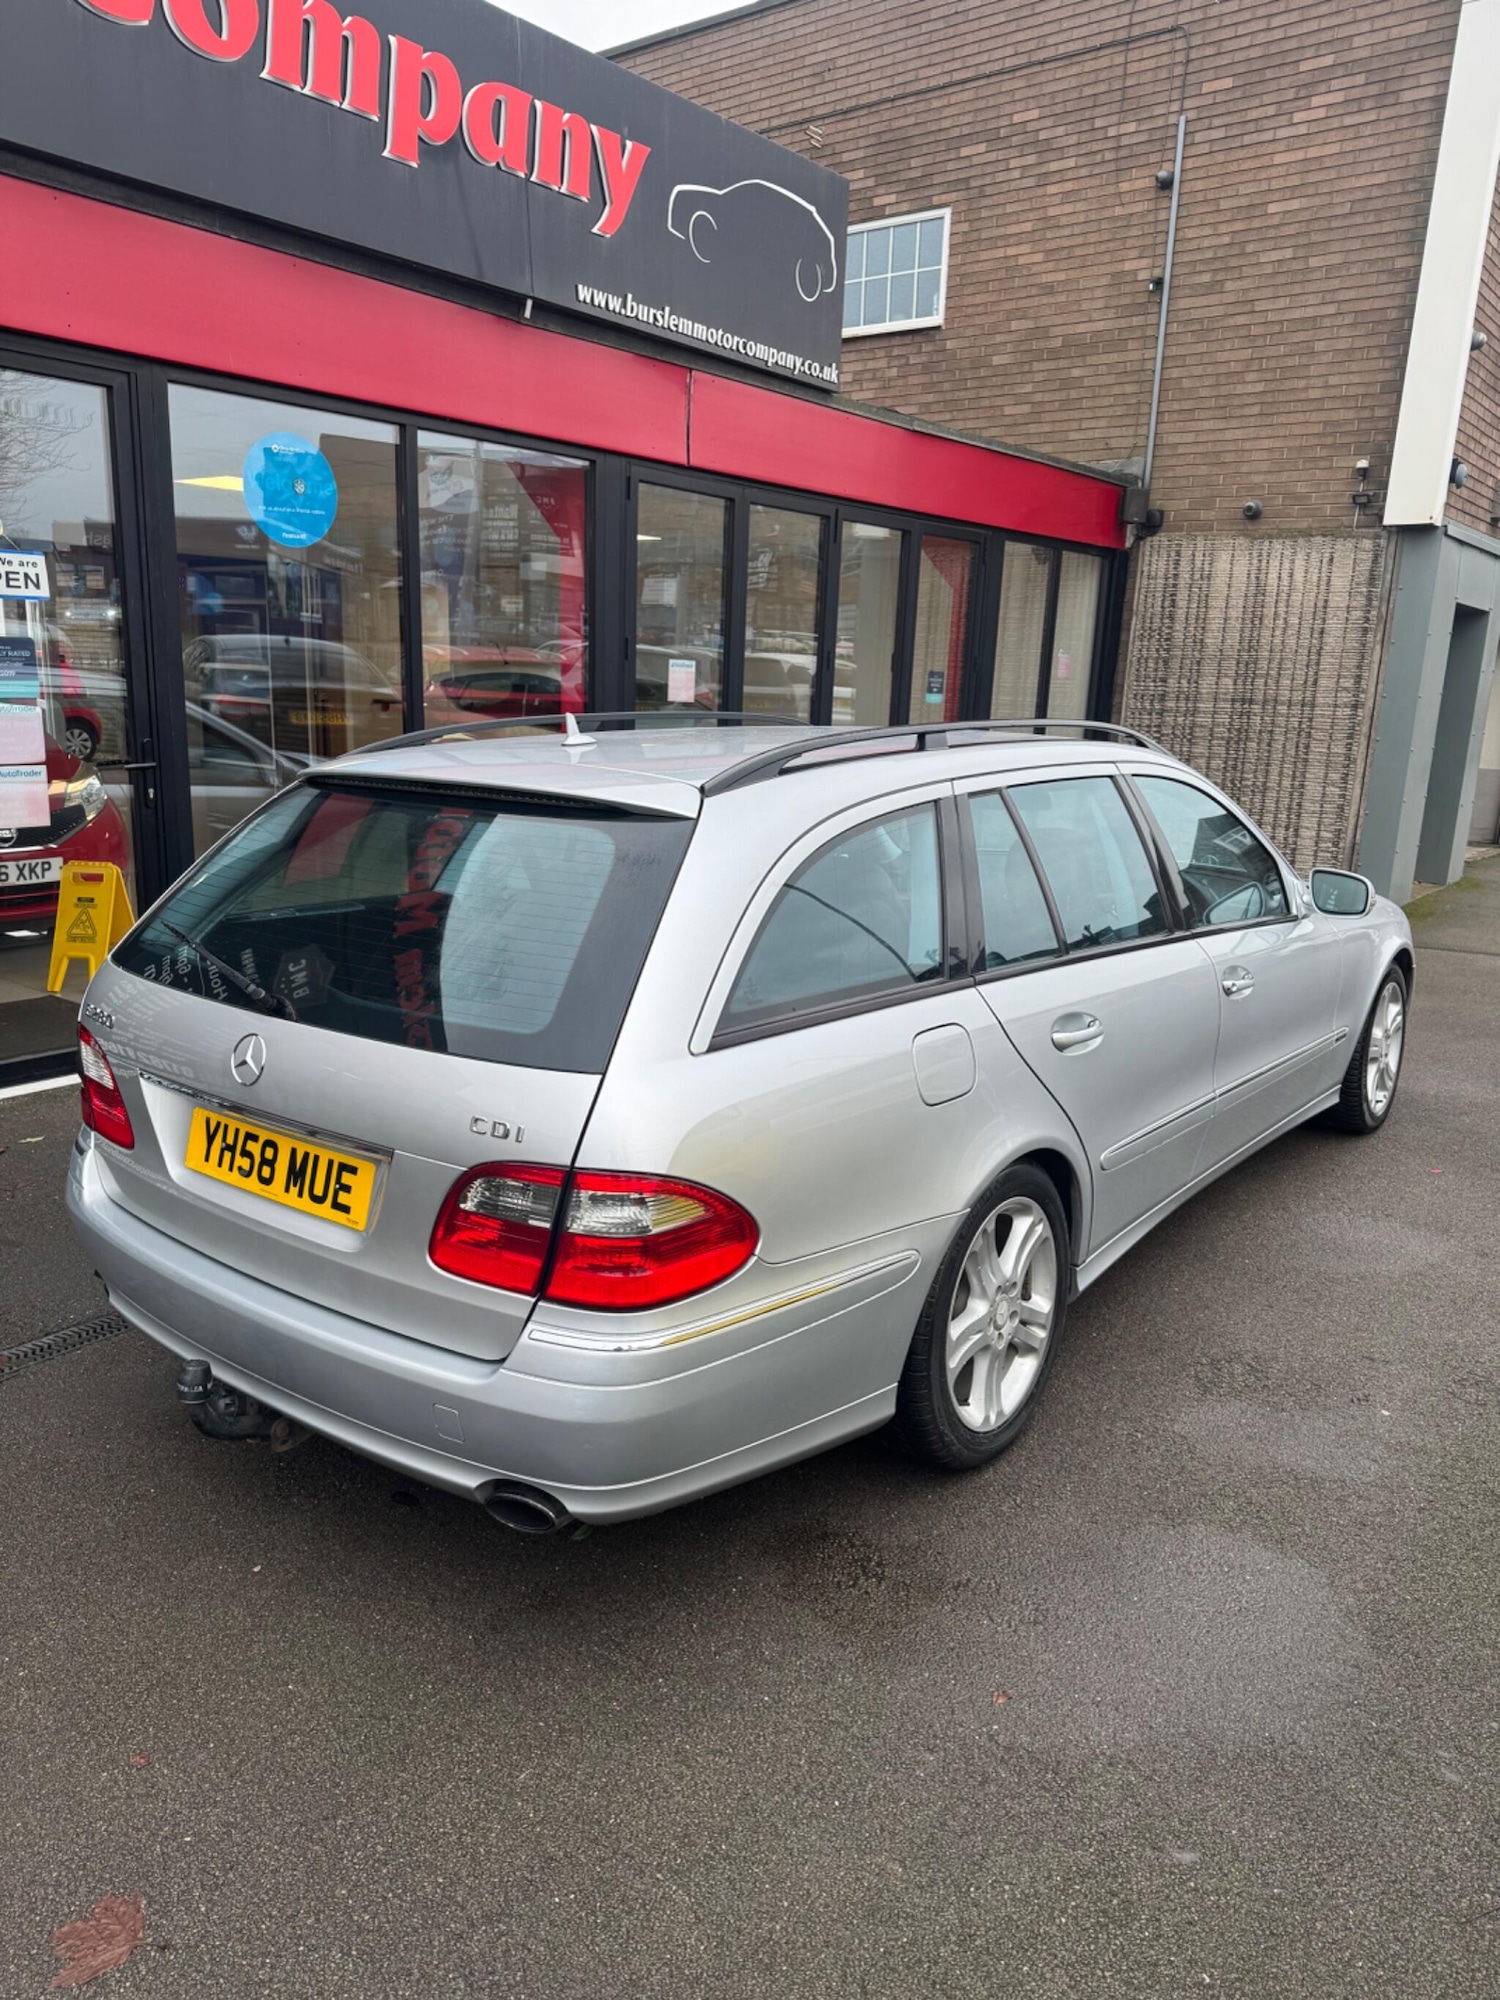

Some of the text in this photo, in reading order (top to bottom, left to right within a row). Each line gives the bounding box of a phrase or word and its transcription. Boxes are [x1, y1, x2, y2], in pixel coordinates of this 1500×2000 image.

[65, 0, 652, 238] ompany
[576, 283, 839, 385] www.burslemmotorcompany.co.uk
[17, 560, 38, 568] are
[0, 570, 41, 591] EN
[15, 860, 52, 882] XKP
[469, 1116, 525, 1143] CDI
[204, 1116, 280, 1187] YH58
[284, 1146, 359, 1216] MUE
